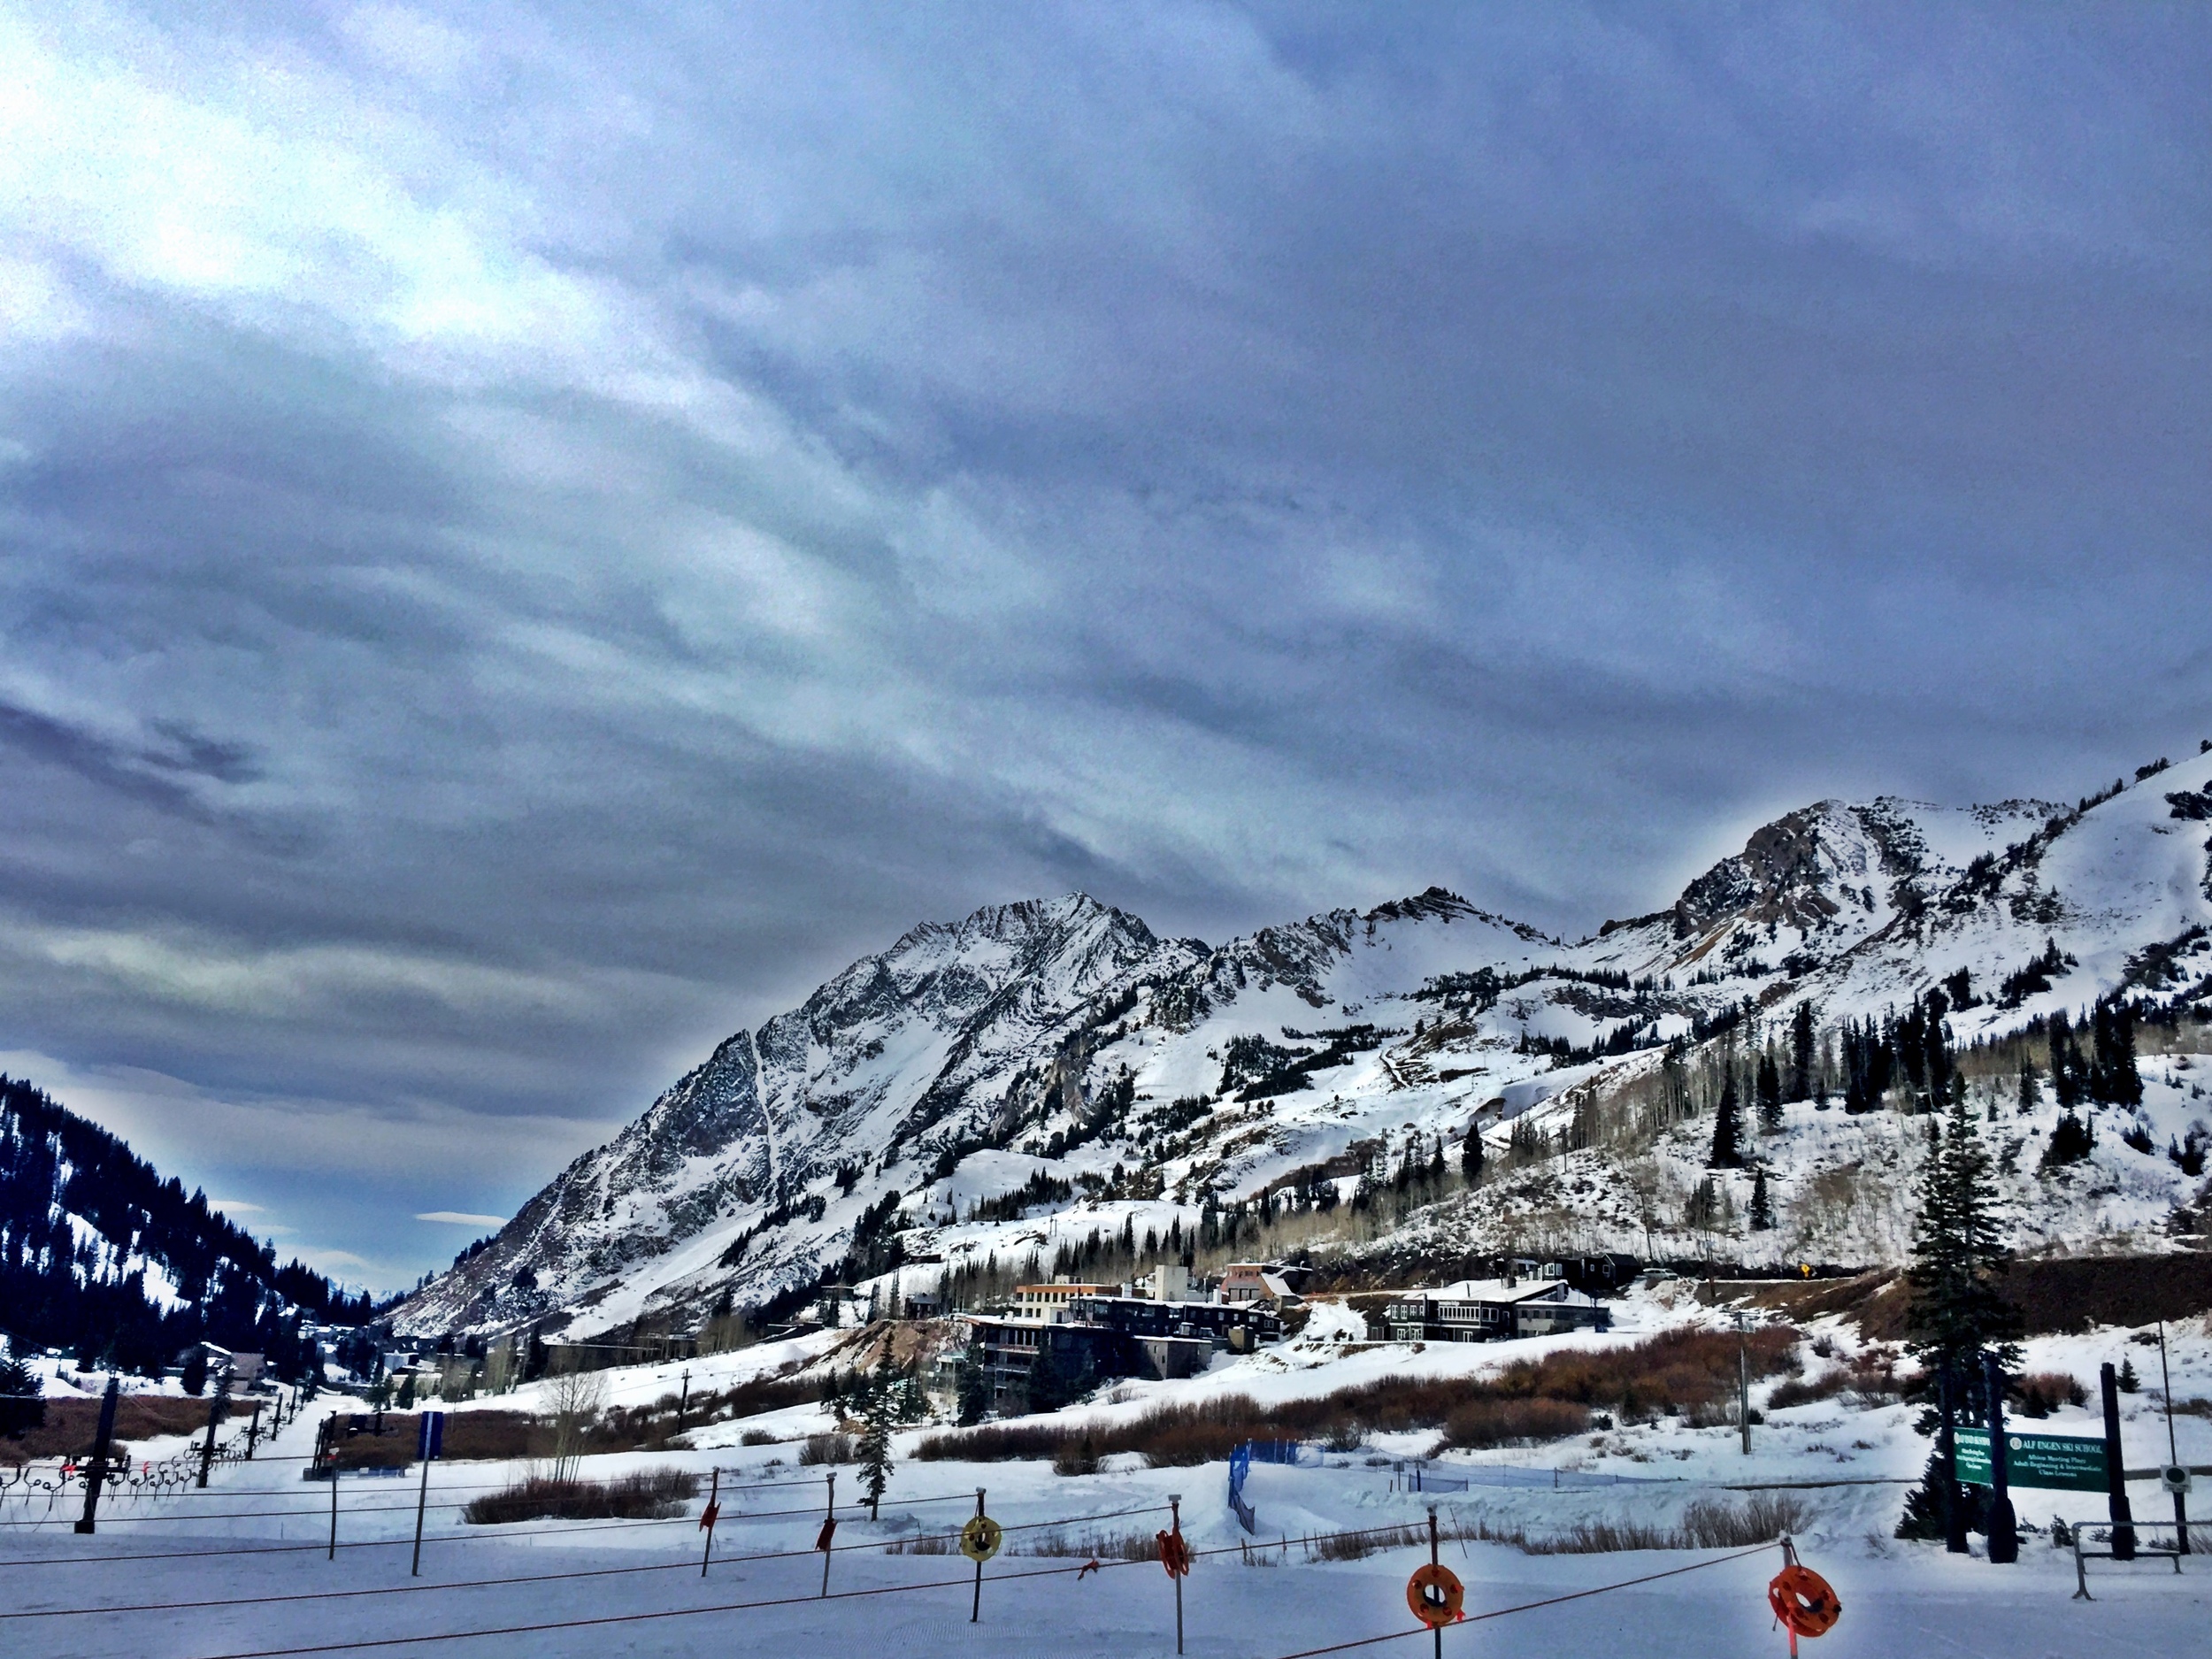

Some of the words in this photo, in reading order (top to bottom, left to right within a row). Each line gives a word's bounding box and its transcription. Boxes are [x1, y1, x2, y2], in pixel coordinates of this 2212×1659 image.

[2023, 1440, 2036, 1449] ALF
[2038, 1441, 2062, 1451] ENGEN
[2062, 1442, 2073, 1452] SKI
[2075, 1443, 2103, 1454] SCHOOL
